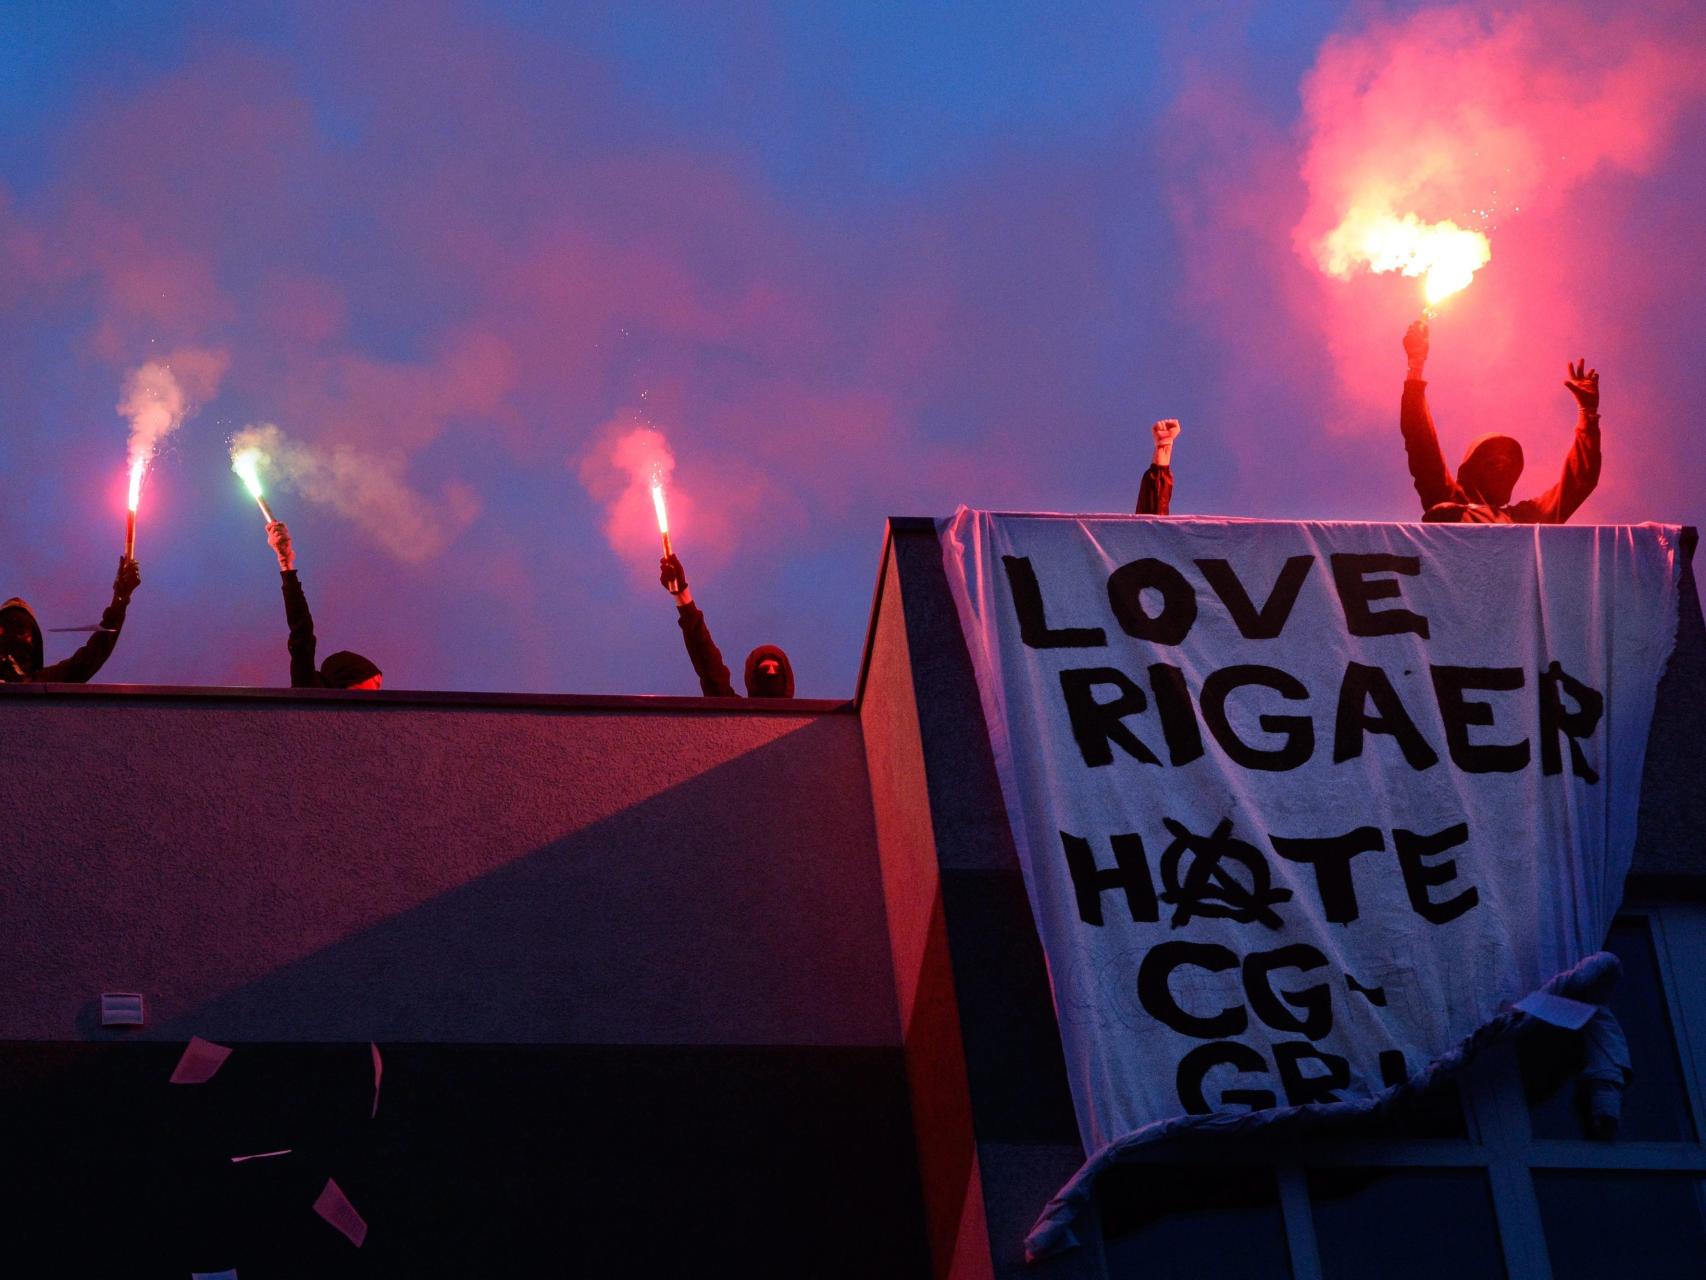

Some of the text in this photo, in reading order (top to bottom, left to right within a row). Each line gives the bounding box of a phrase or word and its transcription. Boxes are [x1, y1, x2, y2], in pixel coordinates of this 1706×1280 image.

[1003, 554, 1429, 648] LOVE
[1060, 662, 1603, 784] RIGAER
[1060, 816, 1479, 930] HATE
